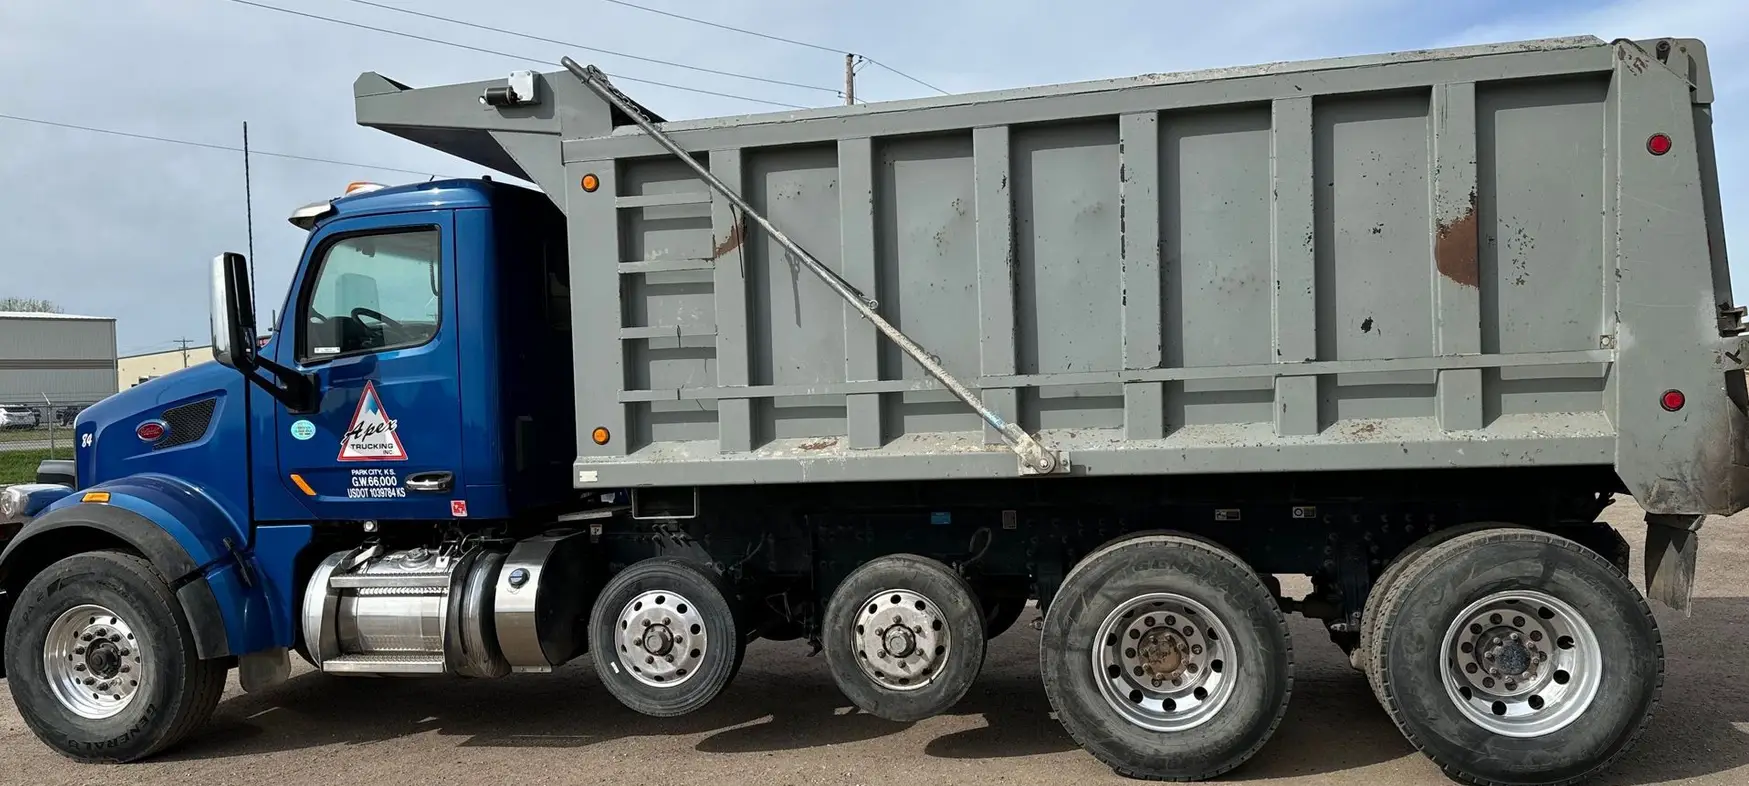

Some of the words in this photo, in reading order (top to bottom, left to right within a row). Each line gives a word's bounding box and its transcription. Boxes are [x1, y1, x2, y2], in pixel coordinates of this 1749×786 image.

[81, 433, 93, 448] 84
[341, 419, 397, 444] Apex
[347, 488, 369, 498] USDOT
[396, 487, 406, 498] KS
[81, 703, 157, 750] GENERAL
